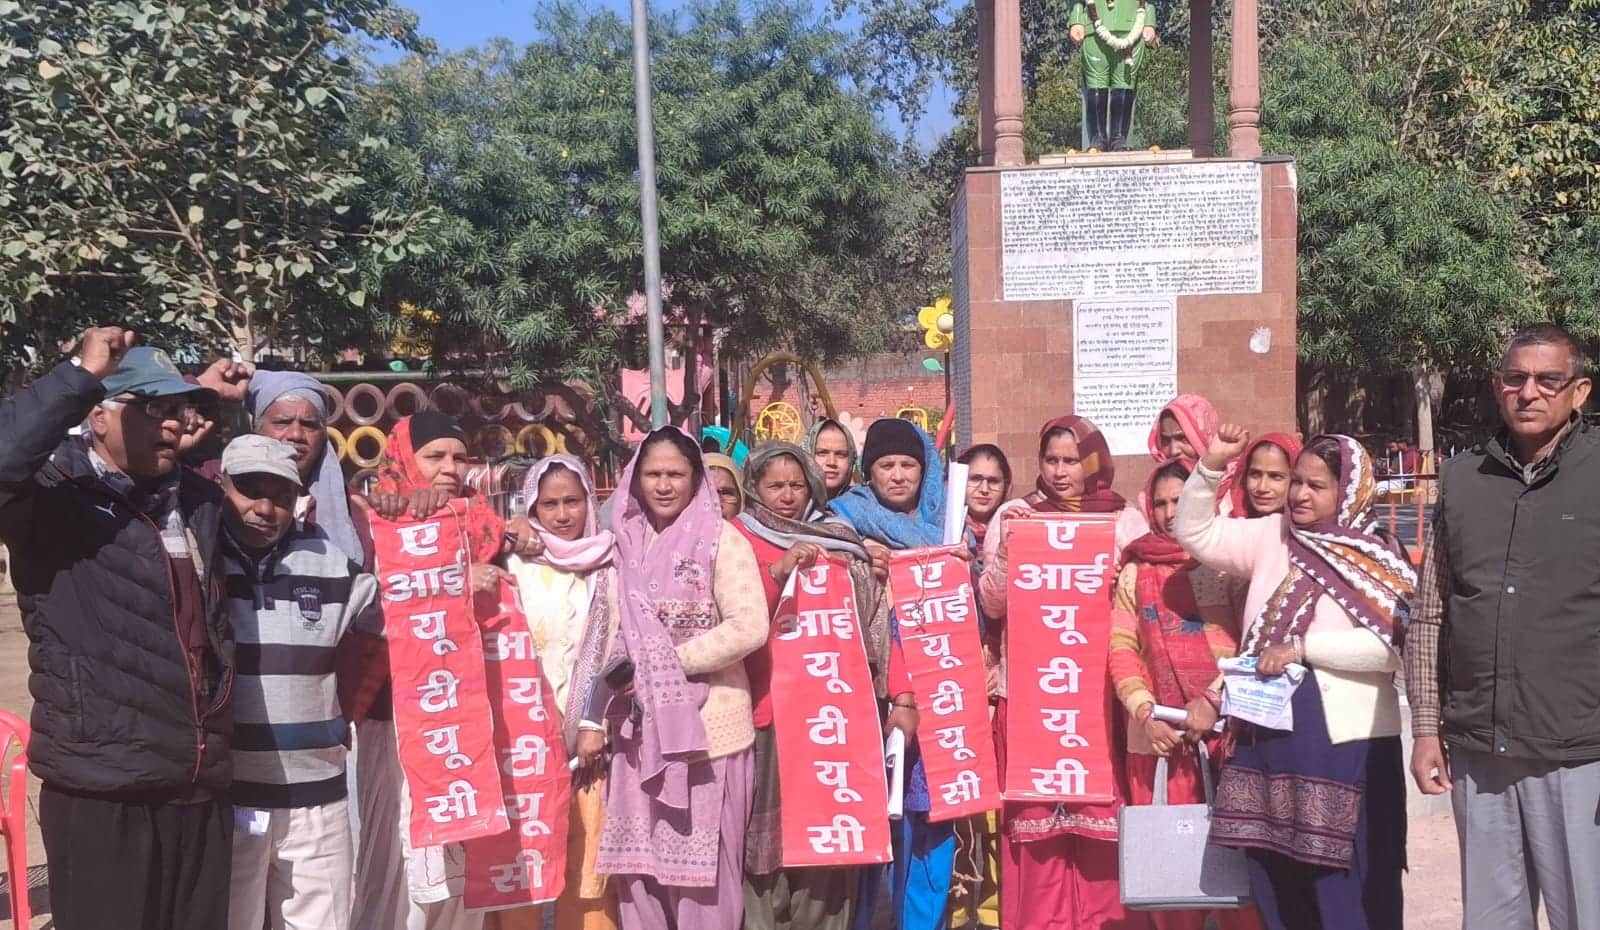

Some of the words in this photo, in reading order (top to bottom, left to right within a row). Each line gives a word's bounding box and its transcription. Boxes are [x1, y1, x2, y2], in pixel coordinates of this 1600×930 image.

[398, 522, 441, 556] ए
[1046, 520, 1080, 550] ए
[385, 549, 467, 602] आई
[799, 564, 830, 594] ए
[910, 561, 946, 588] ए
[1015, 553, 1110, 594] आई
[776, 597, 854, 640] आई
[900, 583, 970, 627] आई
[1041, 605, 1088, 645] यू
[410, 610, 459, 656] यू
[484, 631, 537, 661] आ
[921, 633, 964, 669] यू
[417, 669, 460, 714] टी
[803, 652, 853, 693] यू
[1038, 656, 1083, 694] टी
[508, 677, 549, 721] यू
[930, 679, 965, 715] टी
[807, 704, 848, 745] टी
[937, 725, 976, 761] यू
[1041, 708, 1089, 748] यू
[424, 725, 472, 770] यू
[503, 734, 551, 777] टी
[815, 760, 863, 803] यू
[941, 769, 980, 805] सी
[1031, 758, 1088, 795] सी
[426, 779, 479, 823] सी
[506, 793, 551, 836] यू
[808, 814, 866, 853] सी
[490, 849, 546, 892] सी
